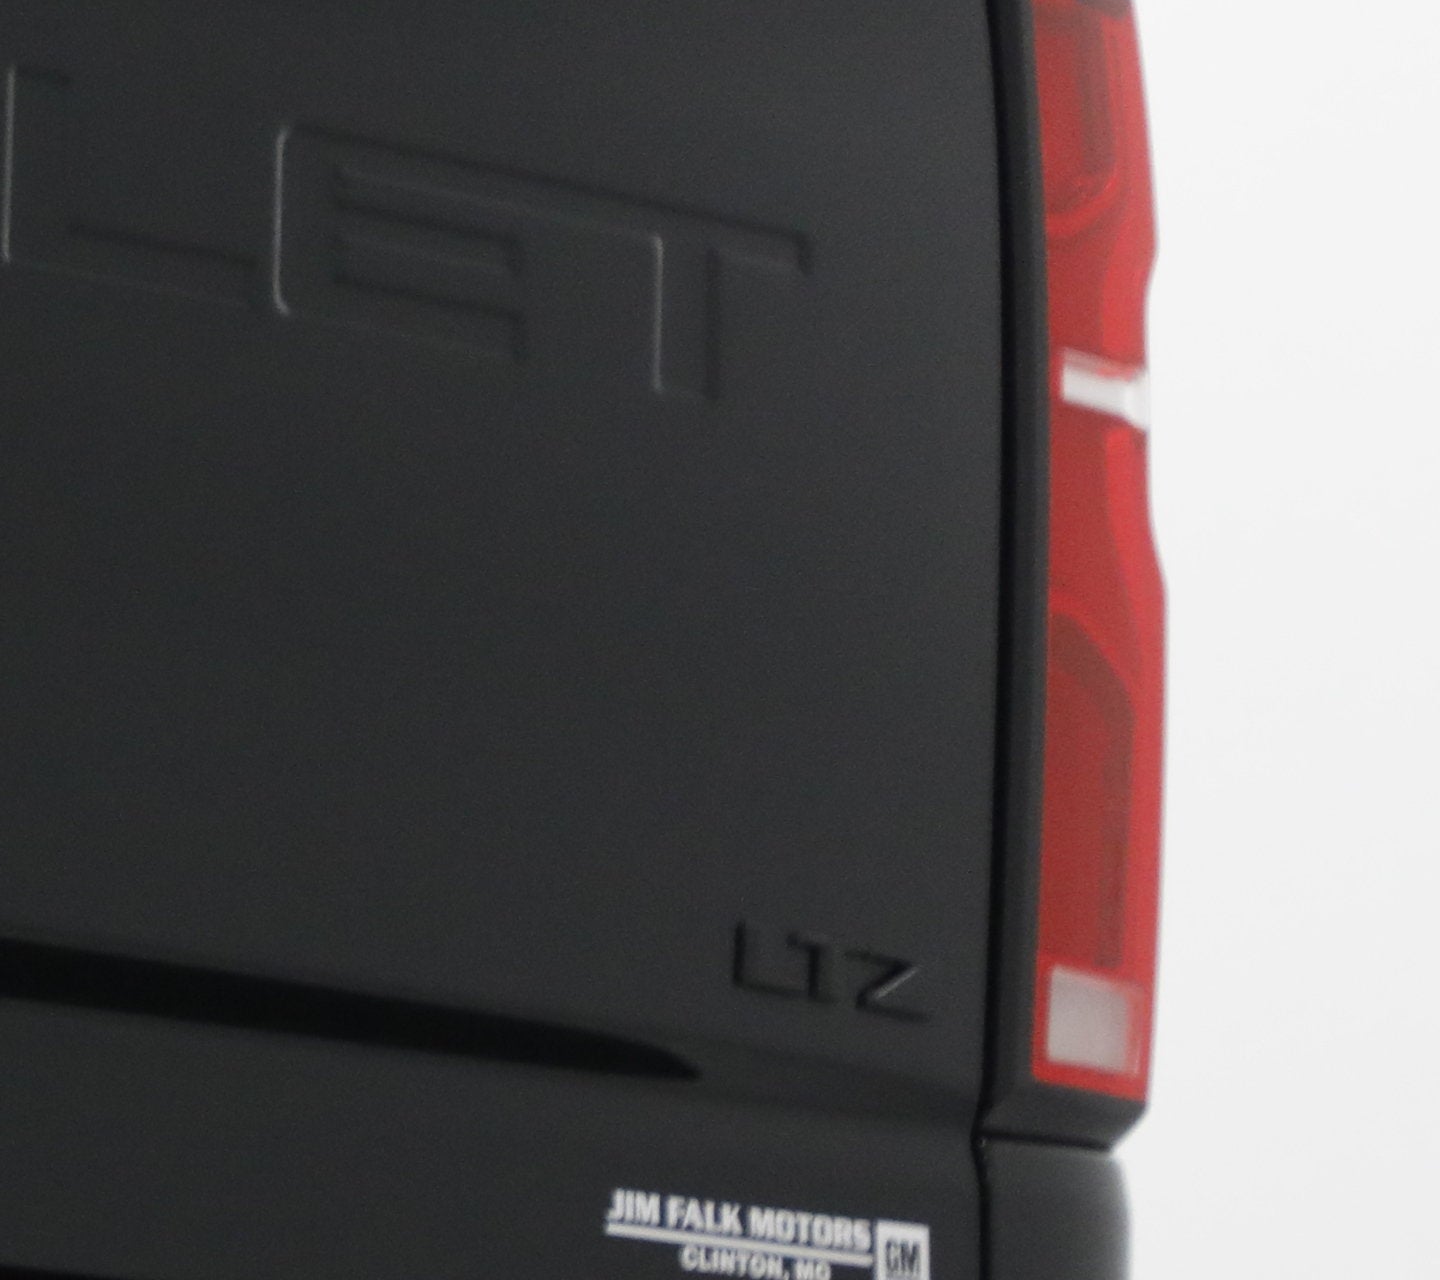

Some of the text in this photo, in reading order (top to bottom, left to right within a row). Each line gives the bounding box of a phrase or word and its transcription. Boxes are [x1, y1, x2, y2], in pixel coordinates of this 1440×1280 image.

[730, 920, 934, 1026] LTZ
[606, 1186, 872, 1250] JIM FALK MOTORS
[886, 1240, 923, 1276] GM
